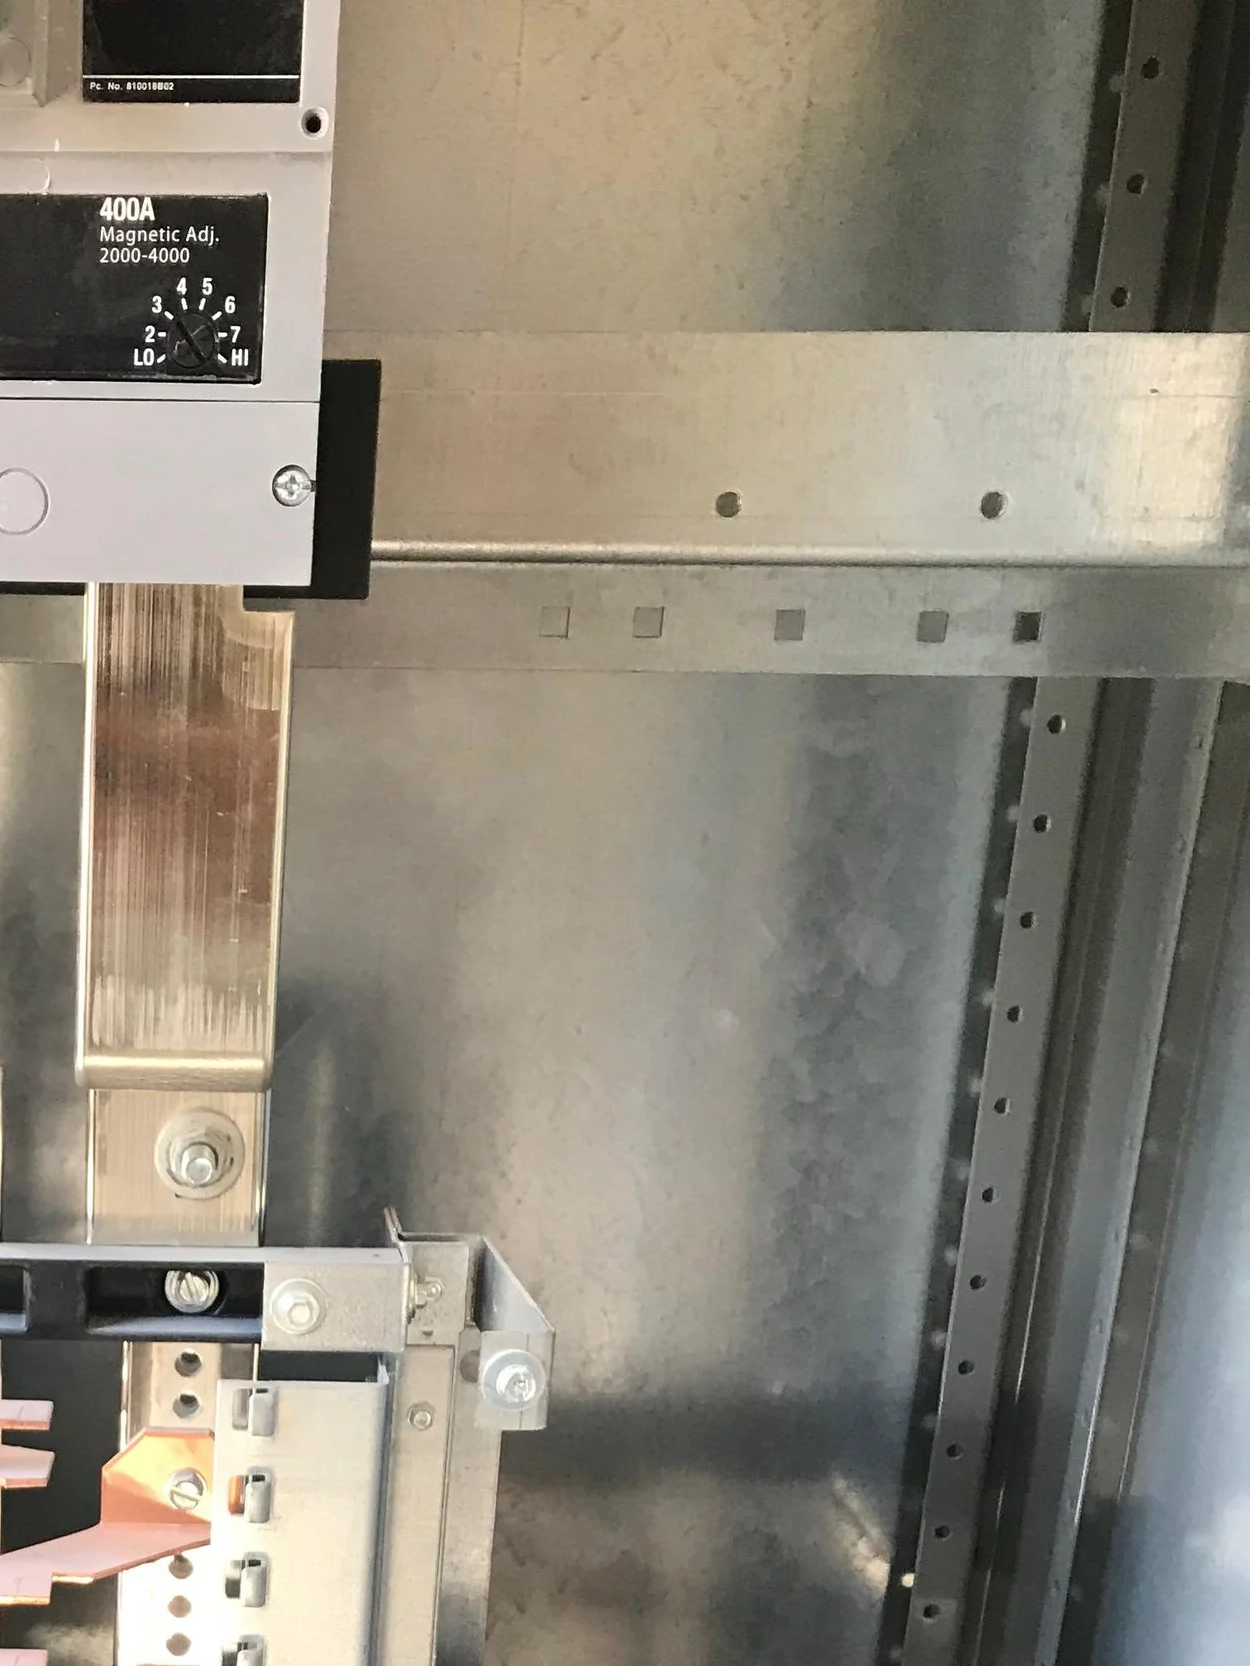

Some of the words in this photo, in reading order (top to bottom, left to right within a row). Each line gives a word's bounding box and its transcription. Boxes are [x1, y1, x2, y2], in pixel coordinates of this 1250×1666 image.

[89, 81, 104, 91] Pc.
[107, 82, 123, 91] No.
[99, 197, 155, 222] 400A
[100, 226, 180, 245] Magnetic
[185, 226, 220, 244] Adj.
[99, 247, 190, 264] 2000-4000
[176, 278, 187, 295] 4
[201, 278, 213, 295] 5
[151, 296, 162, 313] 3
[224, 296, 236, 313] 6
[144, 326, 155, 342] 2
[230, 326, 240, 342] 7
[134, 349, 155, 366] LO
[231, 349, 249, 366] HI
